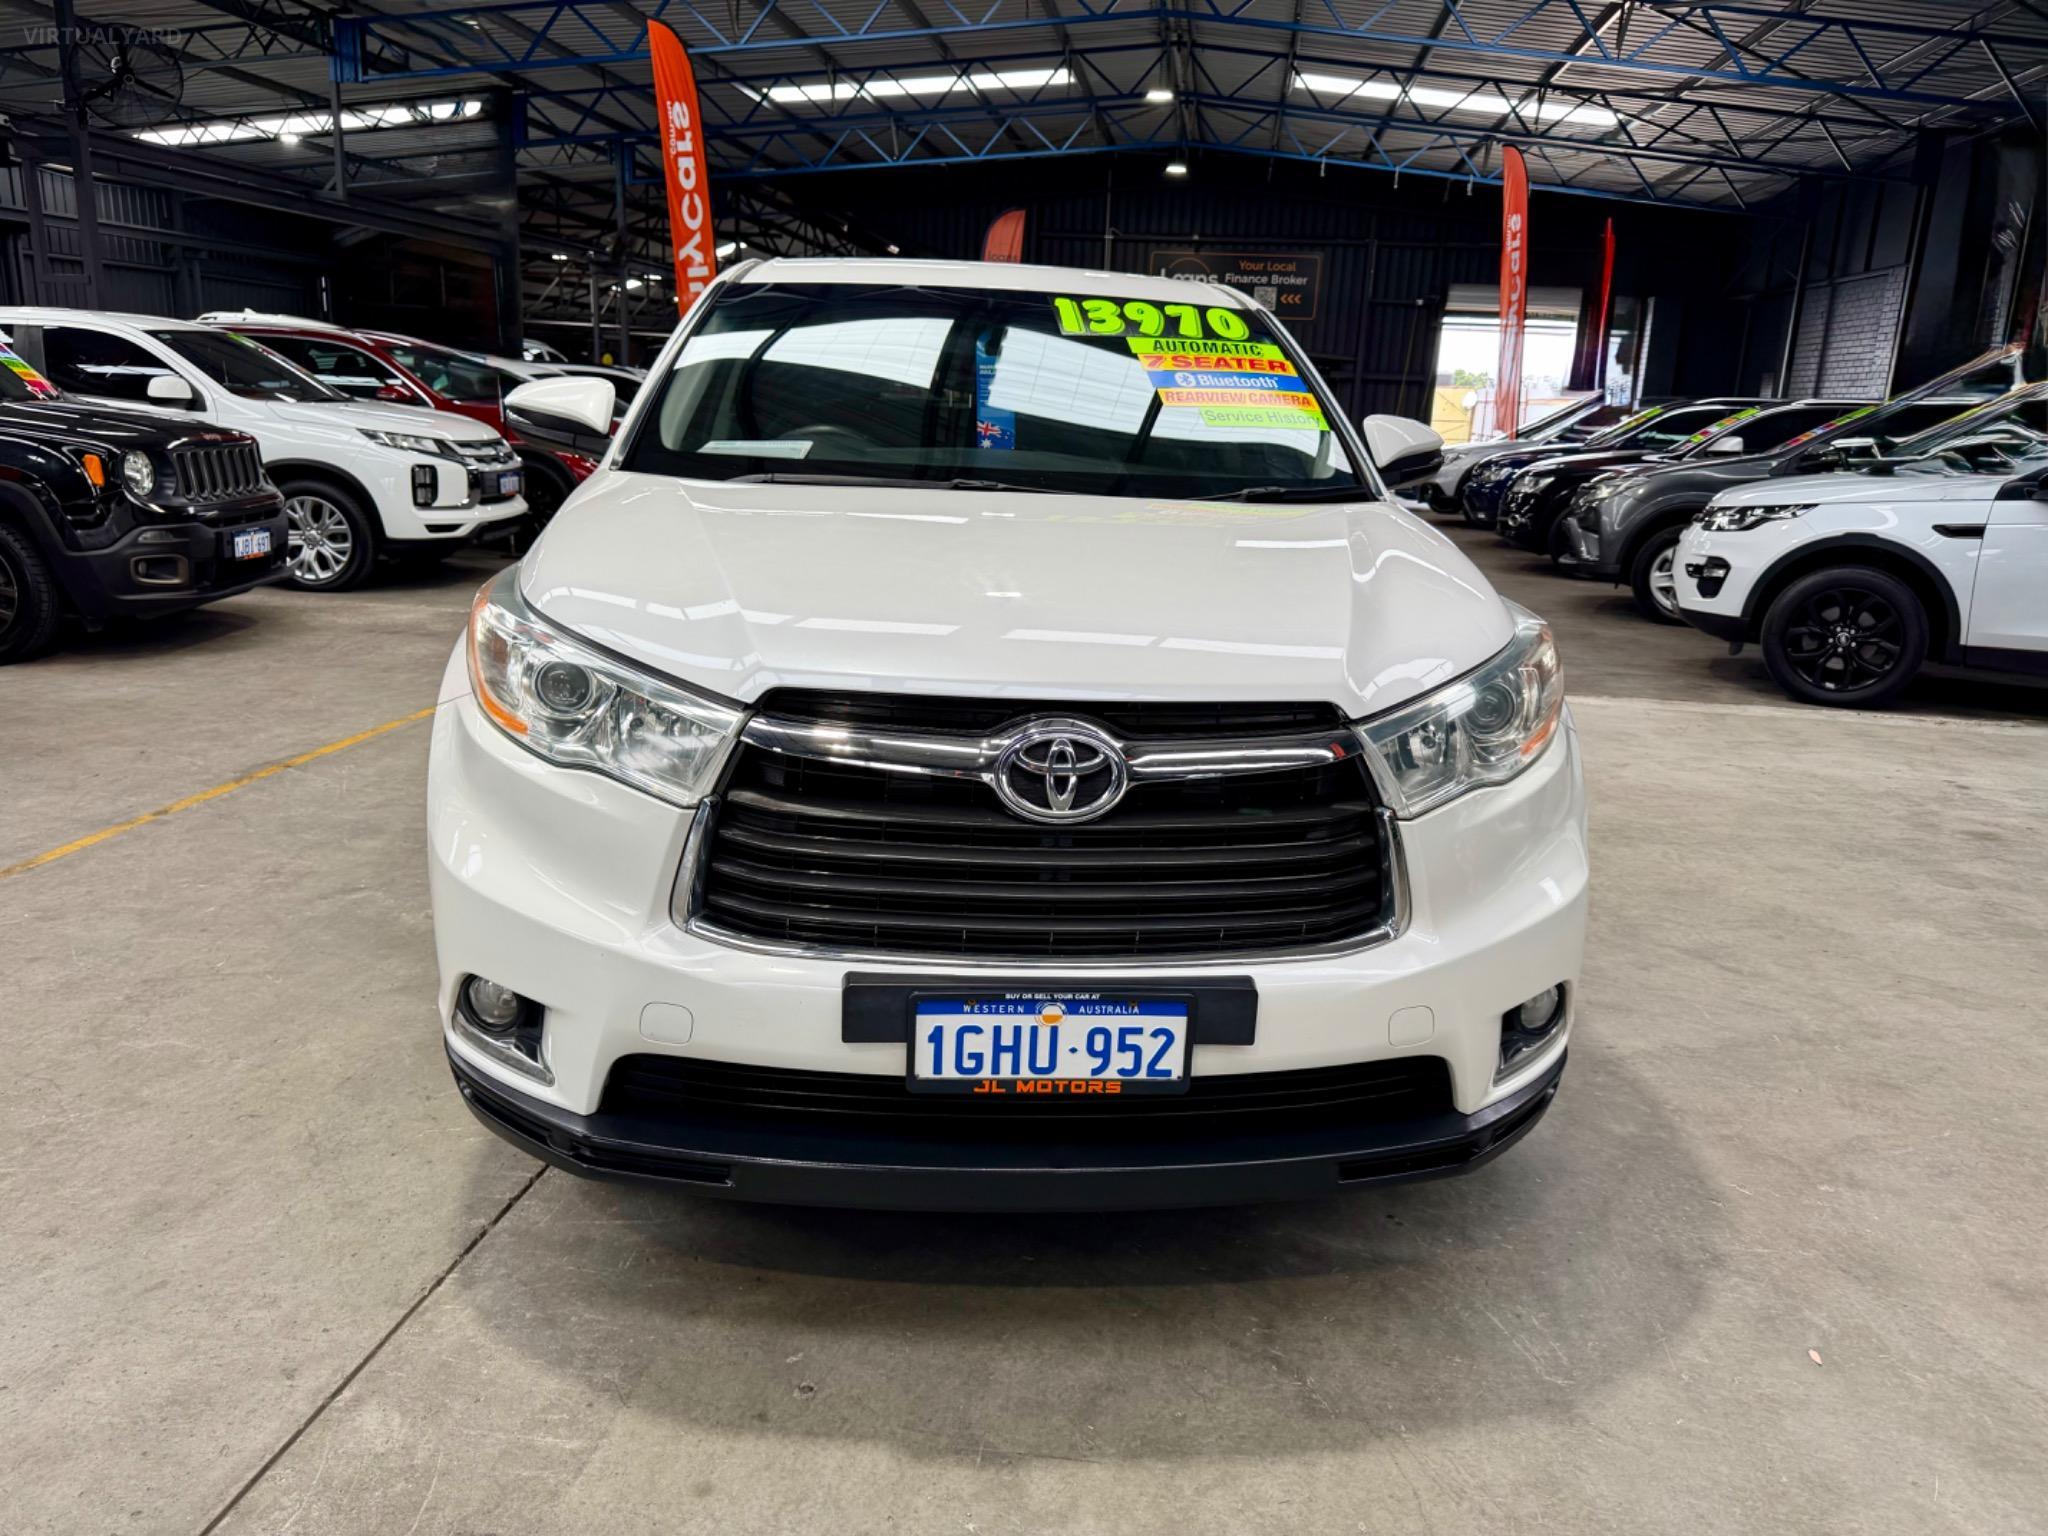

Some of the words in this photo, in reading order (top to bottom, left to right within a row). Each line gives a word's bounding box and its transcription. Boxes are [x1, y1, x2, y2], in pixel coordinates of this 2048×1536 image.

[1238, 260, 1264, 272] Your
[1267, 261, 1297, 272] Local
[1224, 273, 1269, 284] Finance
[1271, 274, 1308, 286] Broker
[1054, 296, 1250, 340] 13970
[1153, 339, 1263, 357] AUTOMATIC
[1147, 354, 1167, 369] 7
[1171, 355, 1288, 373] SEATER
[1164, 390, 1245, 405] REARVIEW
[1249, 391, 1312, 408] CAMERA
[1206, 409, 1264, 423] Service
[1266, 411, 1321, 427] History
[963, 1004, 1025, 1014] WESTERN
[1078, 1004, 1140, 1015] AUSTRALIA
[973, 1080, 1006, 1093] JL
[1016, 1080, 1122, 1094] MOTORS
